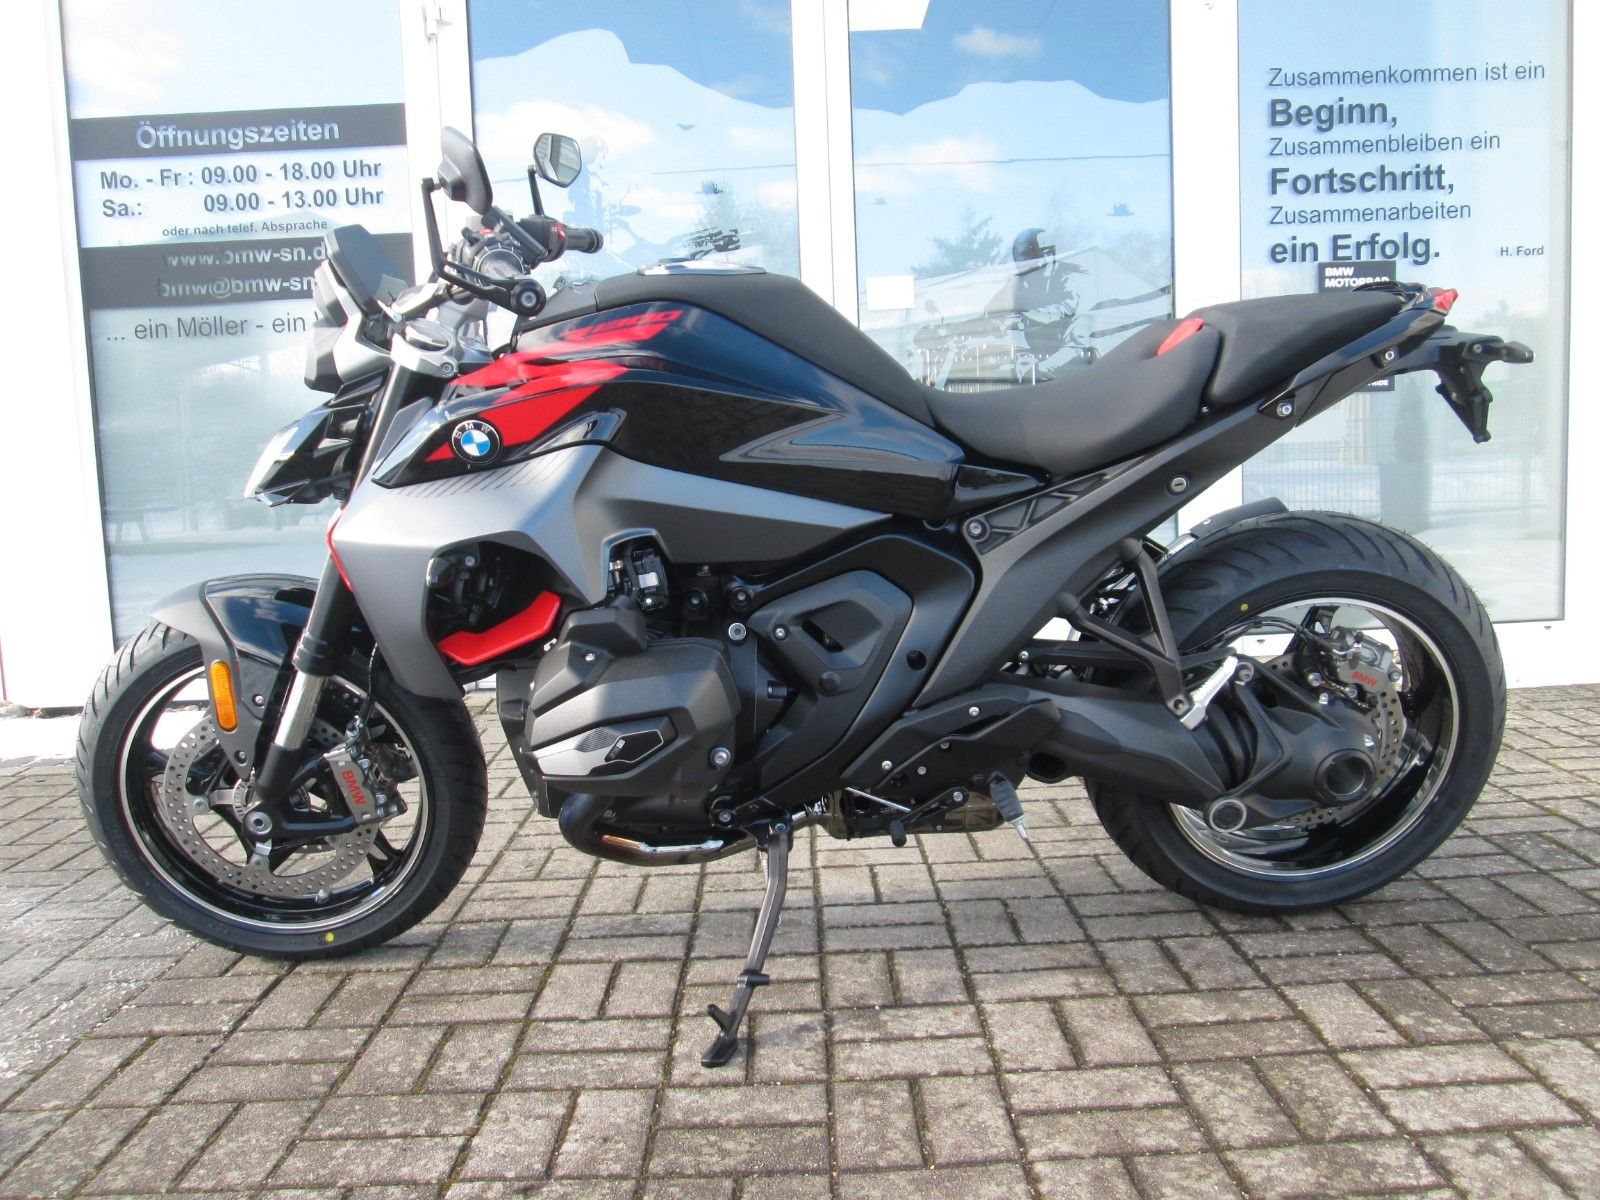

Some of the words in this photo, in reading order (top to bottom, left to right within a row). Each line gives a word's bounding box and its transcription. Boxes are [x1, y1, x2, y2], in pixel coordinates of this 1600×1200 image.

[1268, 63, 1477, 87] Zusammenkommen
[1484, 62, 1507, 80] ist
[1515, 61, 1545, 79] ein
[1270, 96, 1397, 132] Beginn,
[136, 119, 340, 150] Öffnungszeiten
[1268, 132, 1463, 156] Zusammenbleiben
[1470, 131, 1500, 150] ein
[100, 171, 139, 190] Mo.
[201, 165, 258, 185] 09.00
[279, 161, 335, 181] 18.00
[343, 159, 381, 178] Uhr
[1270, 163, 1454, 195] Fortschritt,
[102, 198, 142, 217] Sa.:
[203, 192, 260, 212] 09.00
[282, 188, 338, 208] 13.00
[345, 187, 384, 206] Uhr
[1269, 201, 1471, 225] Zusammenarbeiten
[193, 223, 224, 235] nach
[227, 222, 257, 234] telef.
[261, 218, 328, 234] Absprache
[163, 241, 325, 267] www.bmw-sn.d
[1270, 235, 1319, 264] ein
[1332, 231, 1440, 266] Erfolg.
[1500, 246, 1513, 257] H.
[1516, 245, 1544, 256] Ford
[1324, 266, 1354, 277] BMW
[158, 275, 316, 299] bmw@bmw-sn
[134, 317, 168, 340] ein
[177, 315, 248, 338] Möller
[272, 311, 306, 333] ein
[454, 421, 491, 439] BMW
[1351, 671, 1377, 686] BMW
[341, 769, 367, 805] BMW
